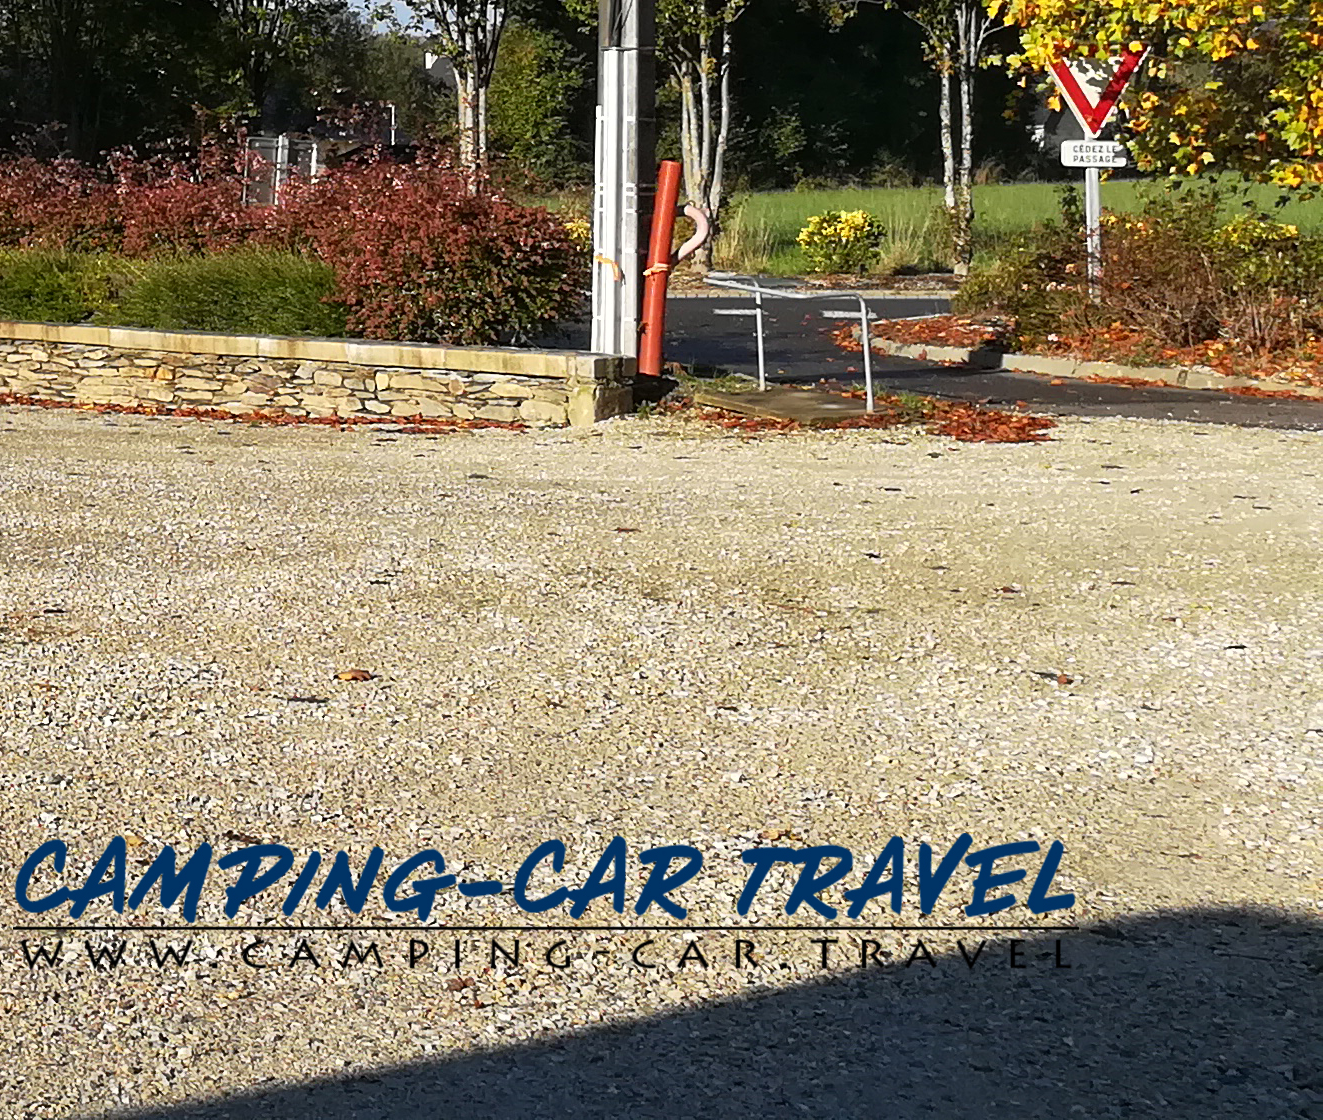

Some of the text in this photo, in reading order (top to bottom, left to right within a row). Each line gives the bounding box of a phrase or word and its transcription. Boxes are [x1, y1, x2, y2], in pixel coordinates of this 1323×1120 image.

[1072, 144, 1118, 153] CÉDEZ LE
[1072, 155, 1117, 163] PASSAGE
